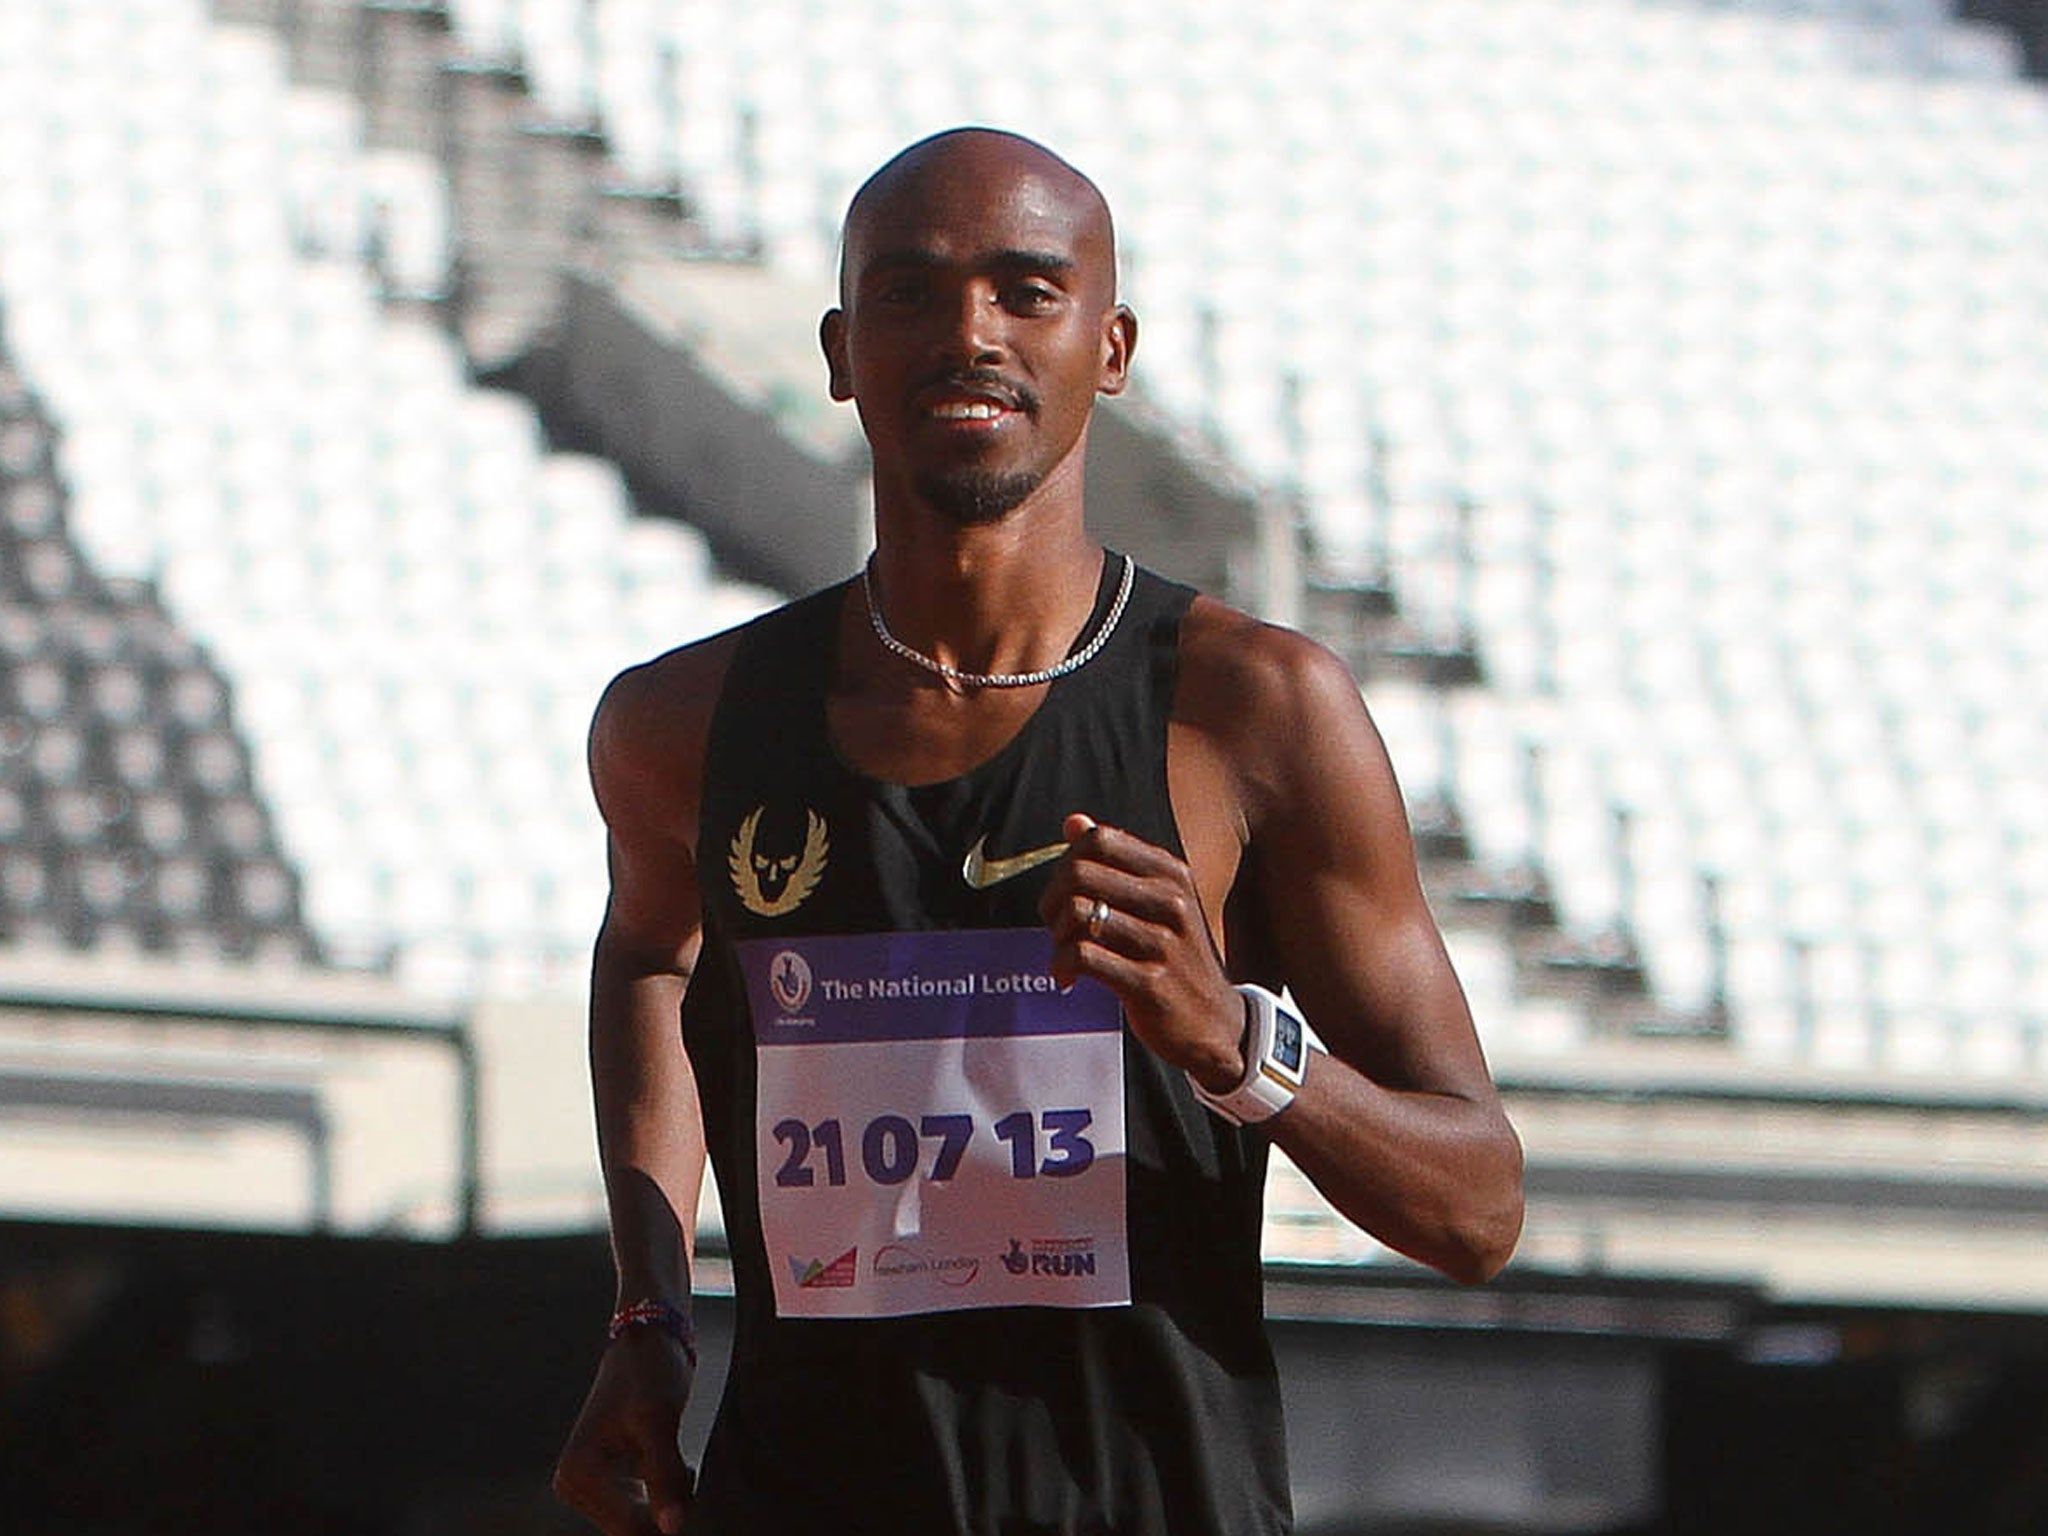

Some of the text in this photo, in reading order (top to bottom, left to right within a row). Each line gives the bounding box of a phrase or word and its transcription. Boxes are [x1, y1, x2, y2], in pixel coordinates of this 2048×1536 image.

[820, 980, 863, 1001] The
[868, 973, 975, 999] National
[772, 1109, 1095, 1187] 21 07 13
[1031, 1253, 1095, 1277] RUN
